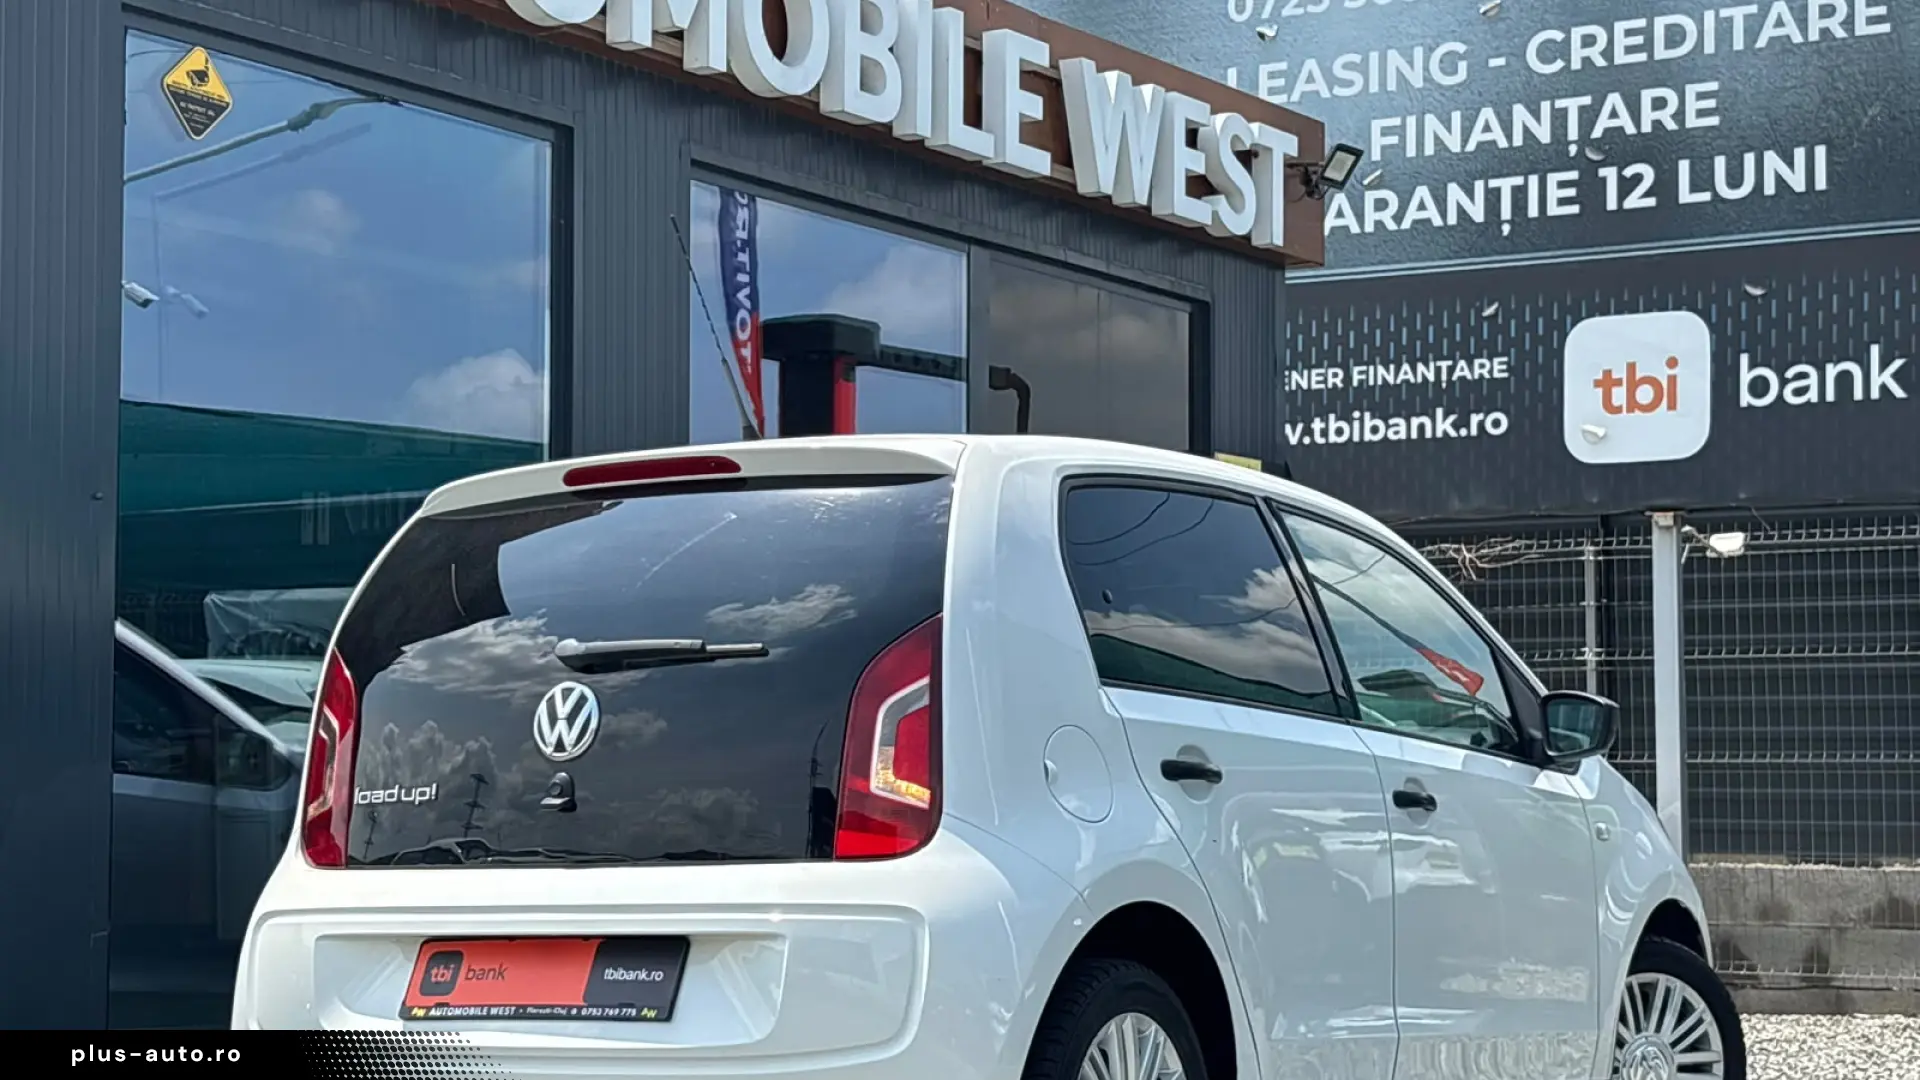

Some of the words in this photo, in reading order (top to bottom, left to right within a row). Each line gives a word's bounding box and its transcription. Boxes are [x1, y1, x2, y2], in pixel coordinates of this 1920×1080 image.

[1524, 0, 1893, 75] CREDITARE
[503, 0, 1052, 179] OBILE
[1059, 58, 1299, 249] WEST
[1370, 81, 1721, 157] FINANȚARE
[1598, 162, 1656, 212] 12
[1678, 144, 1828, 205] LUNI
[1352, 356, 1509, 390] FINANȚARE
[1593, 356, 1679, 416] tbi
[1739, 344, 1908, 409] bank
[354, 784, 399, 805] load
[402, 783, 438, 805] up!
[430, 962, 454, 984] tbi
[464, 963, 508, 982] bank
[603, 966, 665, 983] tbibank.ro
[428, 1006, 489, 1017] AUTOMOBILE
[489, 1006, 517, 1017] WEST
